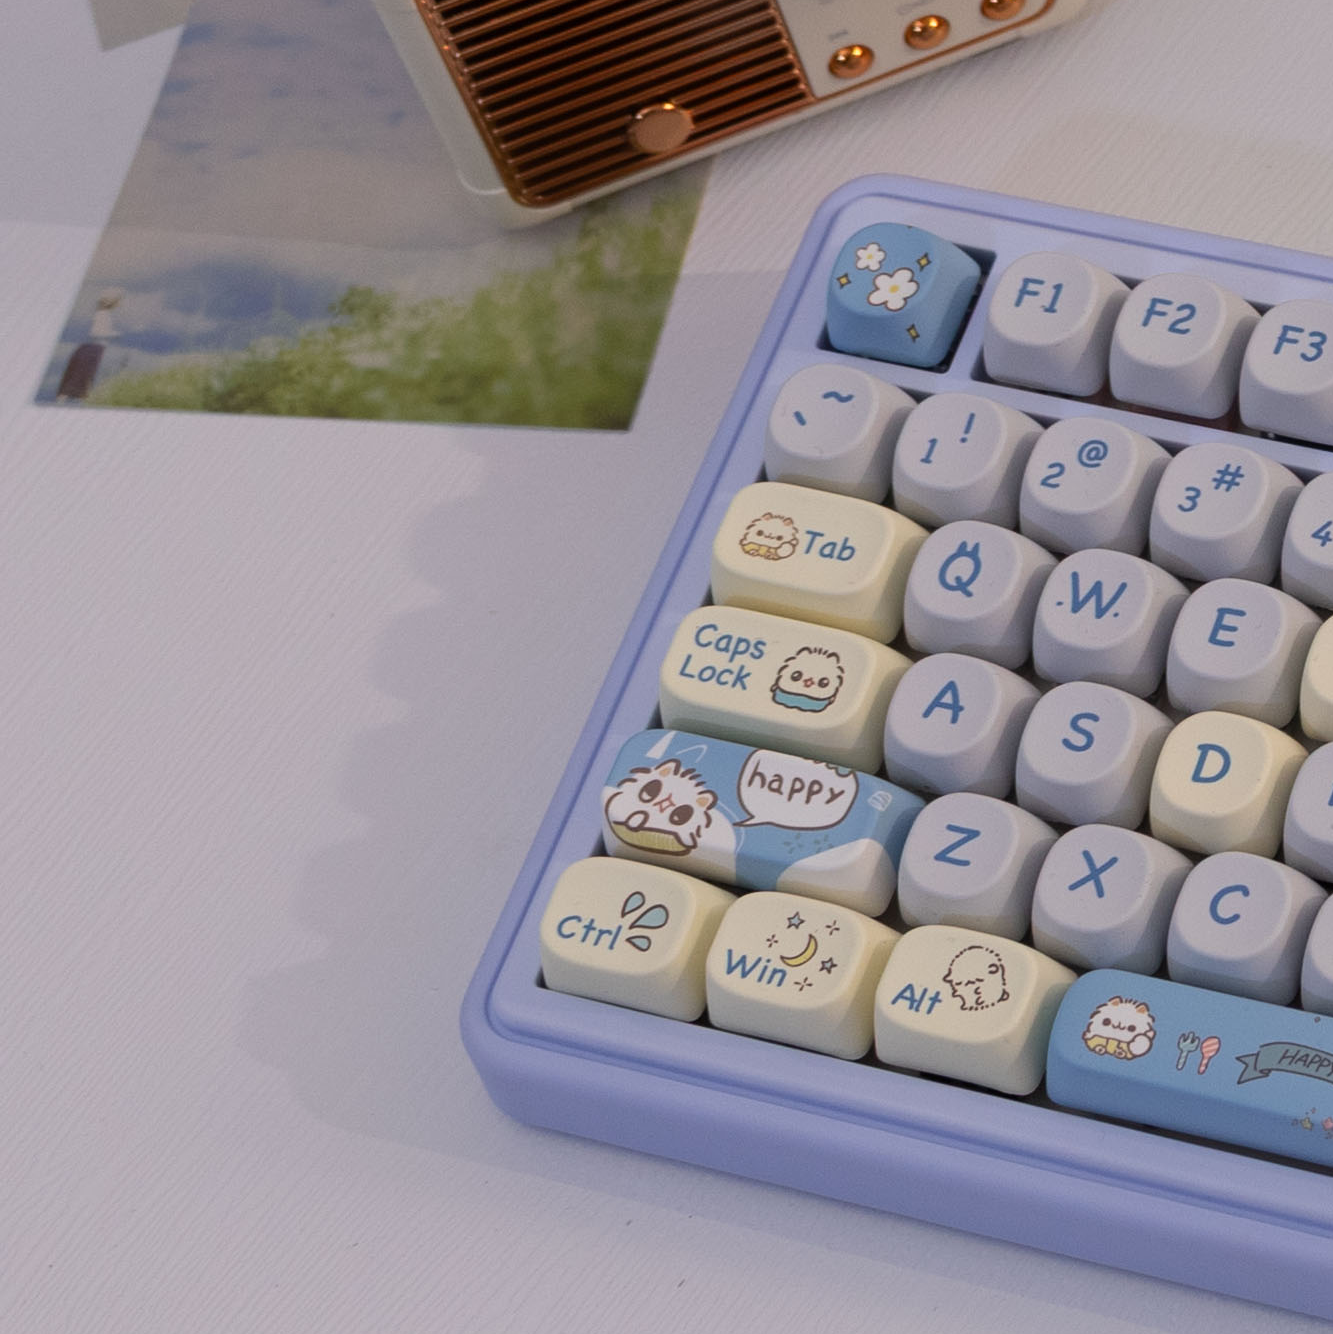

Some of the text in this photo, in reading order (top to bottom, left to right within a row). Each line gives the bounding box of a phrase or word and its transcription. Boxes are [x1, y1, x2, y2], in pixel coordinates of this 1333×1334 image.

[1014, 277, 1064, 314] F1
[1141, 297, 1197, 335] F2
[1273, 324, 1328, 363] F3
[919, 437, 938, 465] 1
[1040, 462, 1065, 489] 2
[1177, 486, 1201, 513] 3
[804, 530, 856, 562] Tab
[1311, 520, 1333, 548] 4
[694, 623, 767, 663] Caps
[1207, 607, 1247, 648] E
[679, 654, 752, 691] Lock
[922, 680, 965, 725] A
[1061, 712, 1100, 753] S
[747, 758, 846, 807] happy
[1191, 743, 1232, 784] D
[933, 823, 981, 867] Z
[1068, 850, 1119, 899] X
[1209, 884, 1250, 926] C
[556, 915, 620, 951] Ctrl
[726, 948, 791, 988] Win
[891, 983, 942, 1015] Alt
